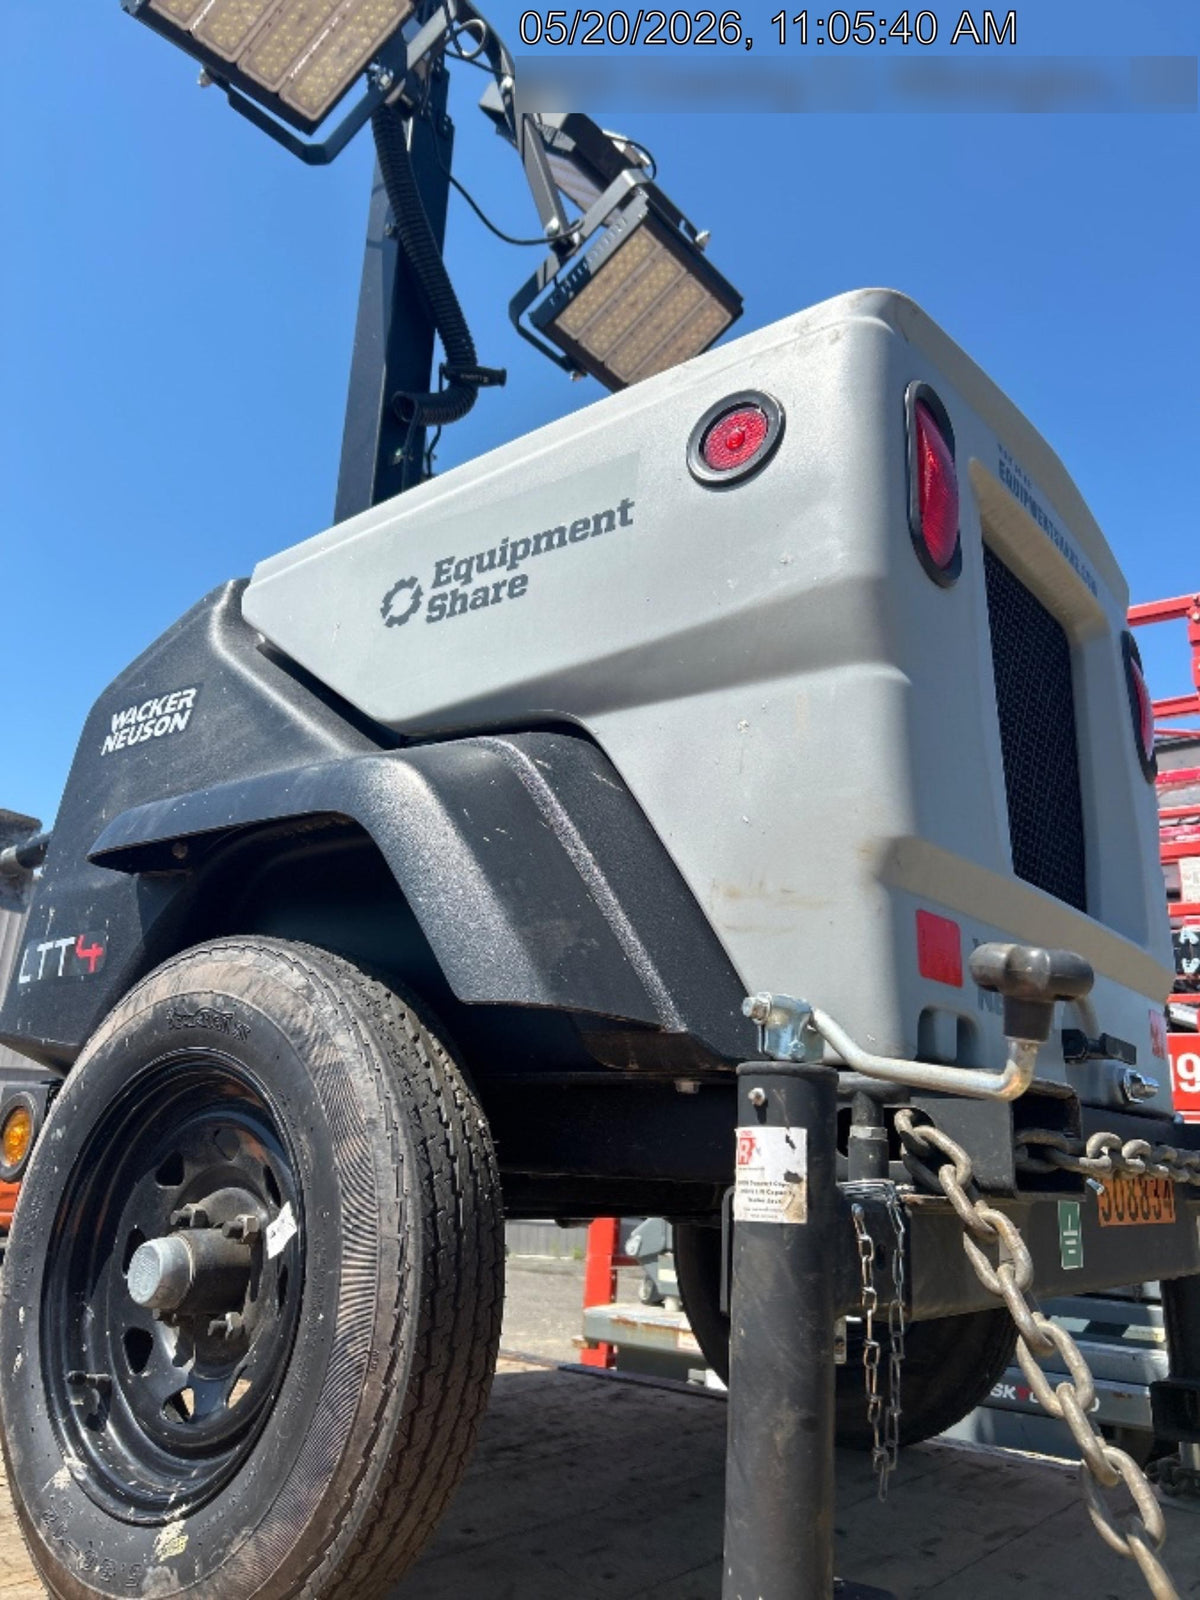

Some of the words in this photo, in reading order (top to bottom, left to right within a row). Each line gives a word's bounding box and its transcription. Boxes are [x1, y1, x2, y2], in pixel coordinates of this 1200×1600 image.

[431, 497, 635, 589] Equipment
[425, 573, 529, 624] Share
[100, 708, 192, 756] NEUSON
[111, 687, 197, 734] WACKER
[18, 934, 104, 984] LTT4
